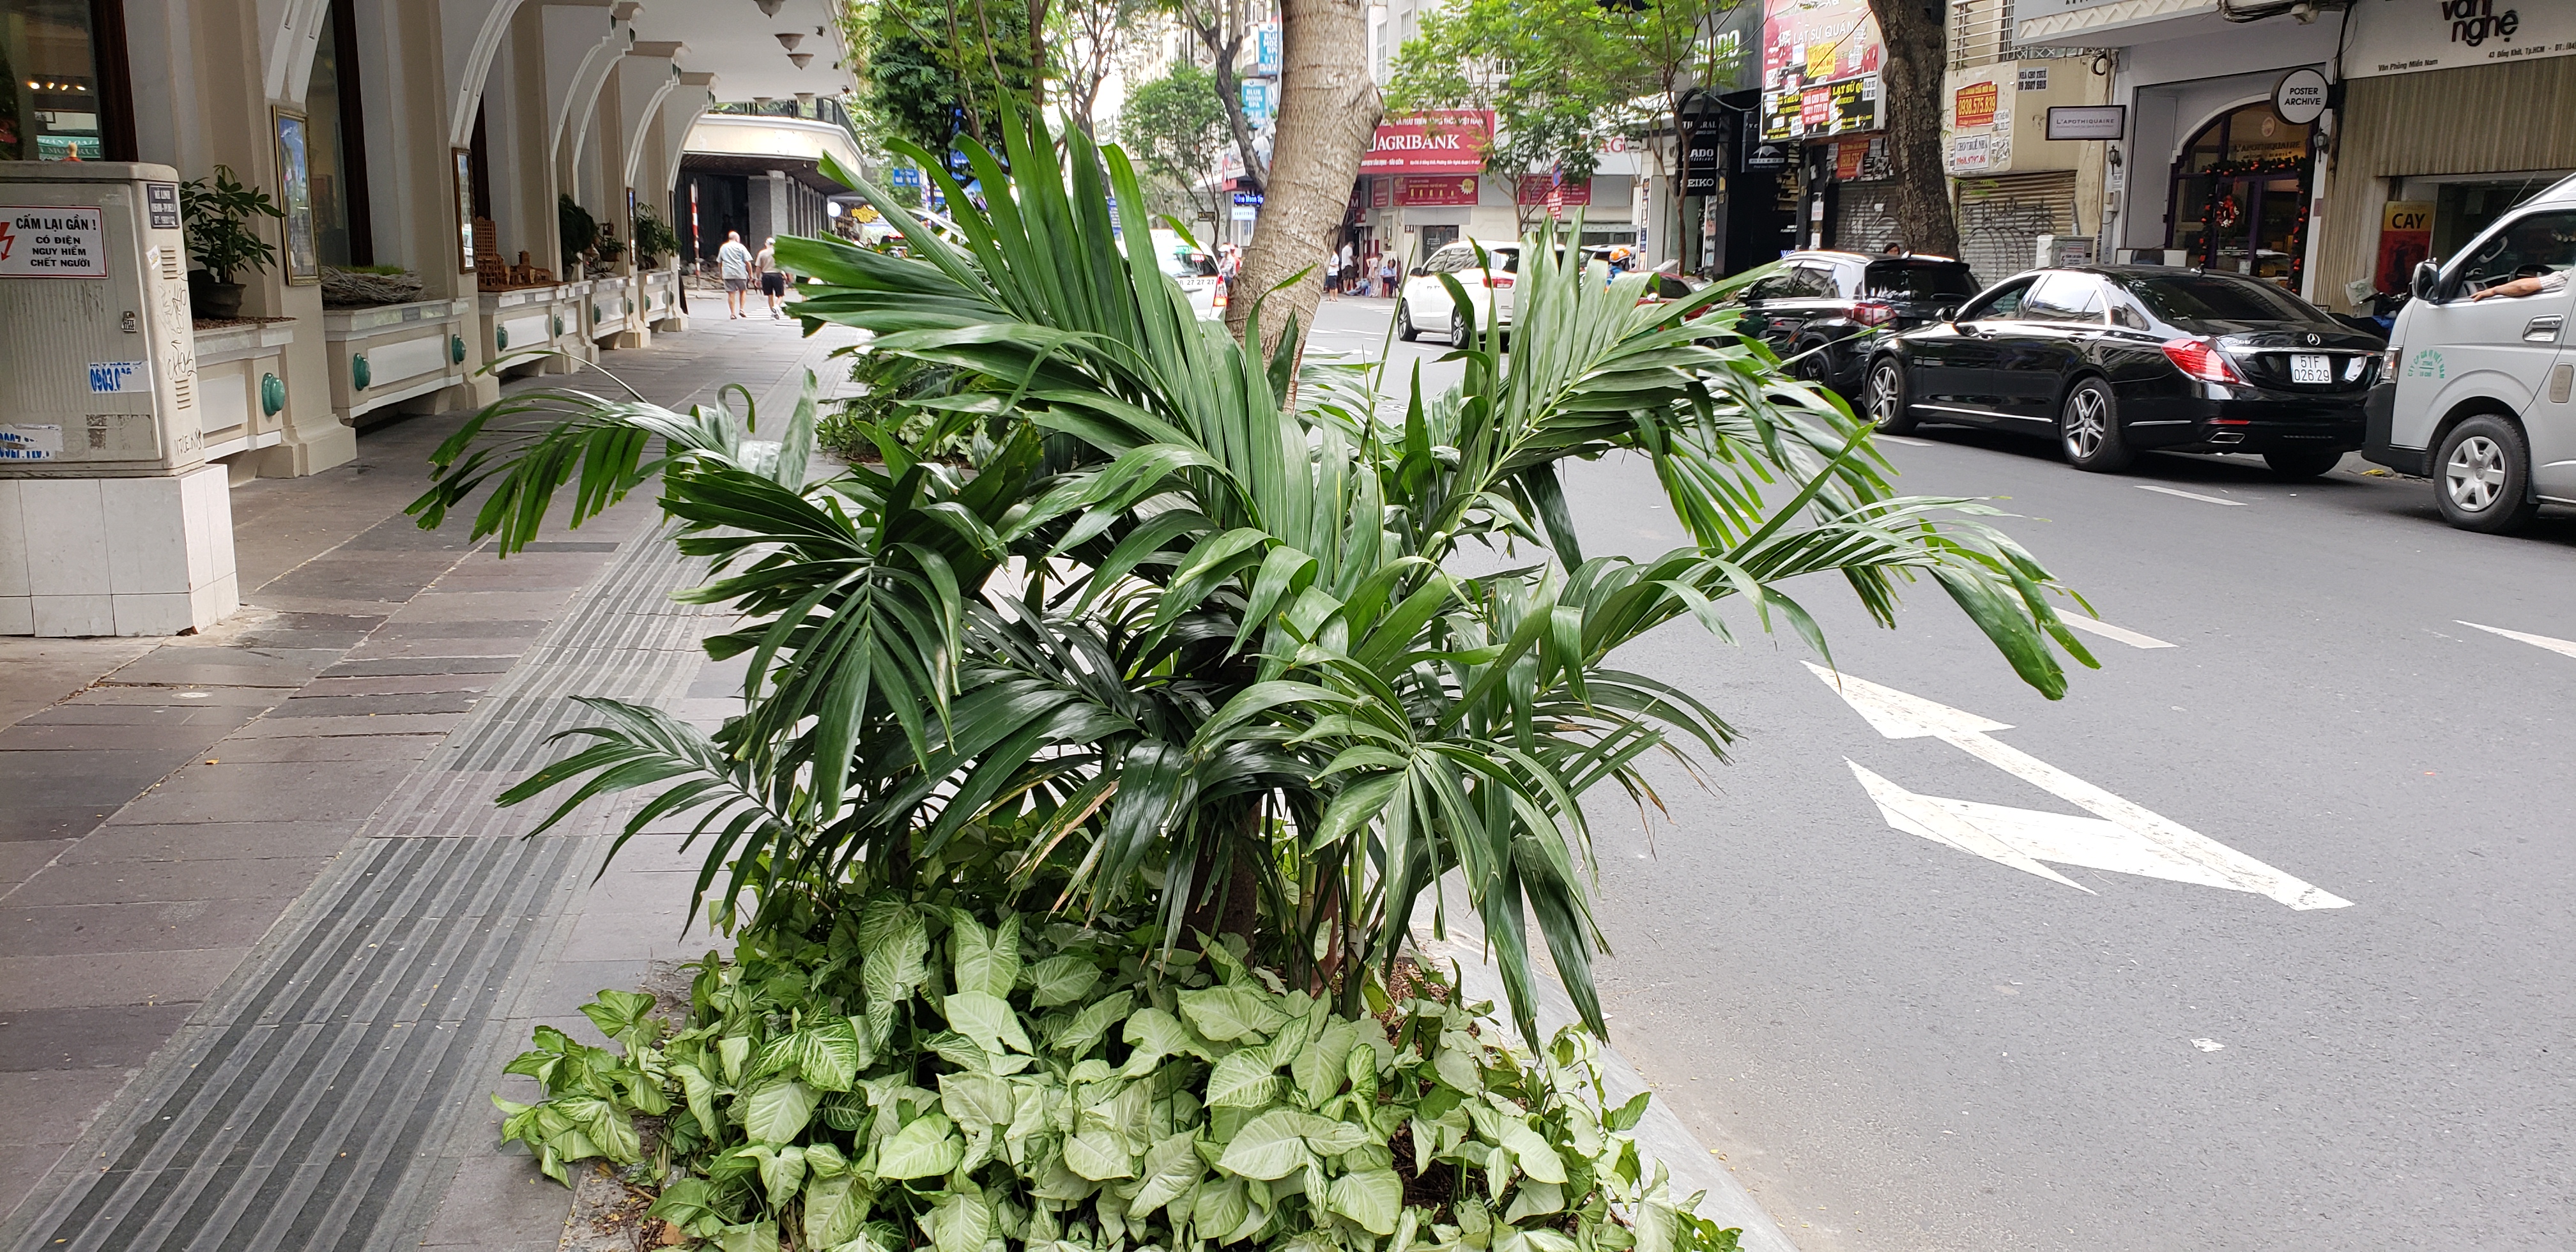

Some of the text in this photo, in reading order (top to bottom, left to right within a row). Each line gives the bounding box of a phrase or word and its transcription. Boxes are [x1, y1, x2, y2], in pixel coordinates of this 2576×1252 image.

[1958, 95, 1996, 116] 0938.575.839
[1377, 134, 1460, 151] AGRIBANK
[16, 213, 41, 230] CẤM
[44, 218, 63, 233] LẠI
[66, 213, 89, 231] GẦN
[2392, 213, 2425, 229] CAY
[36, 234, 80, 245] CÓ ĐIỆN
[61, 245, 86, 256] HIỂM
[31, 257, 90, 267] CHẾT NGƯỜI
[2300, 356, 2320, 369] 51F
[2294, 369, 2329, 382] 026.29
